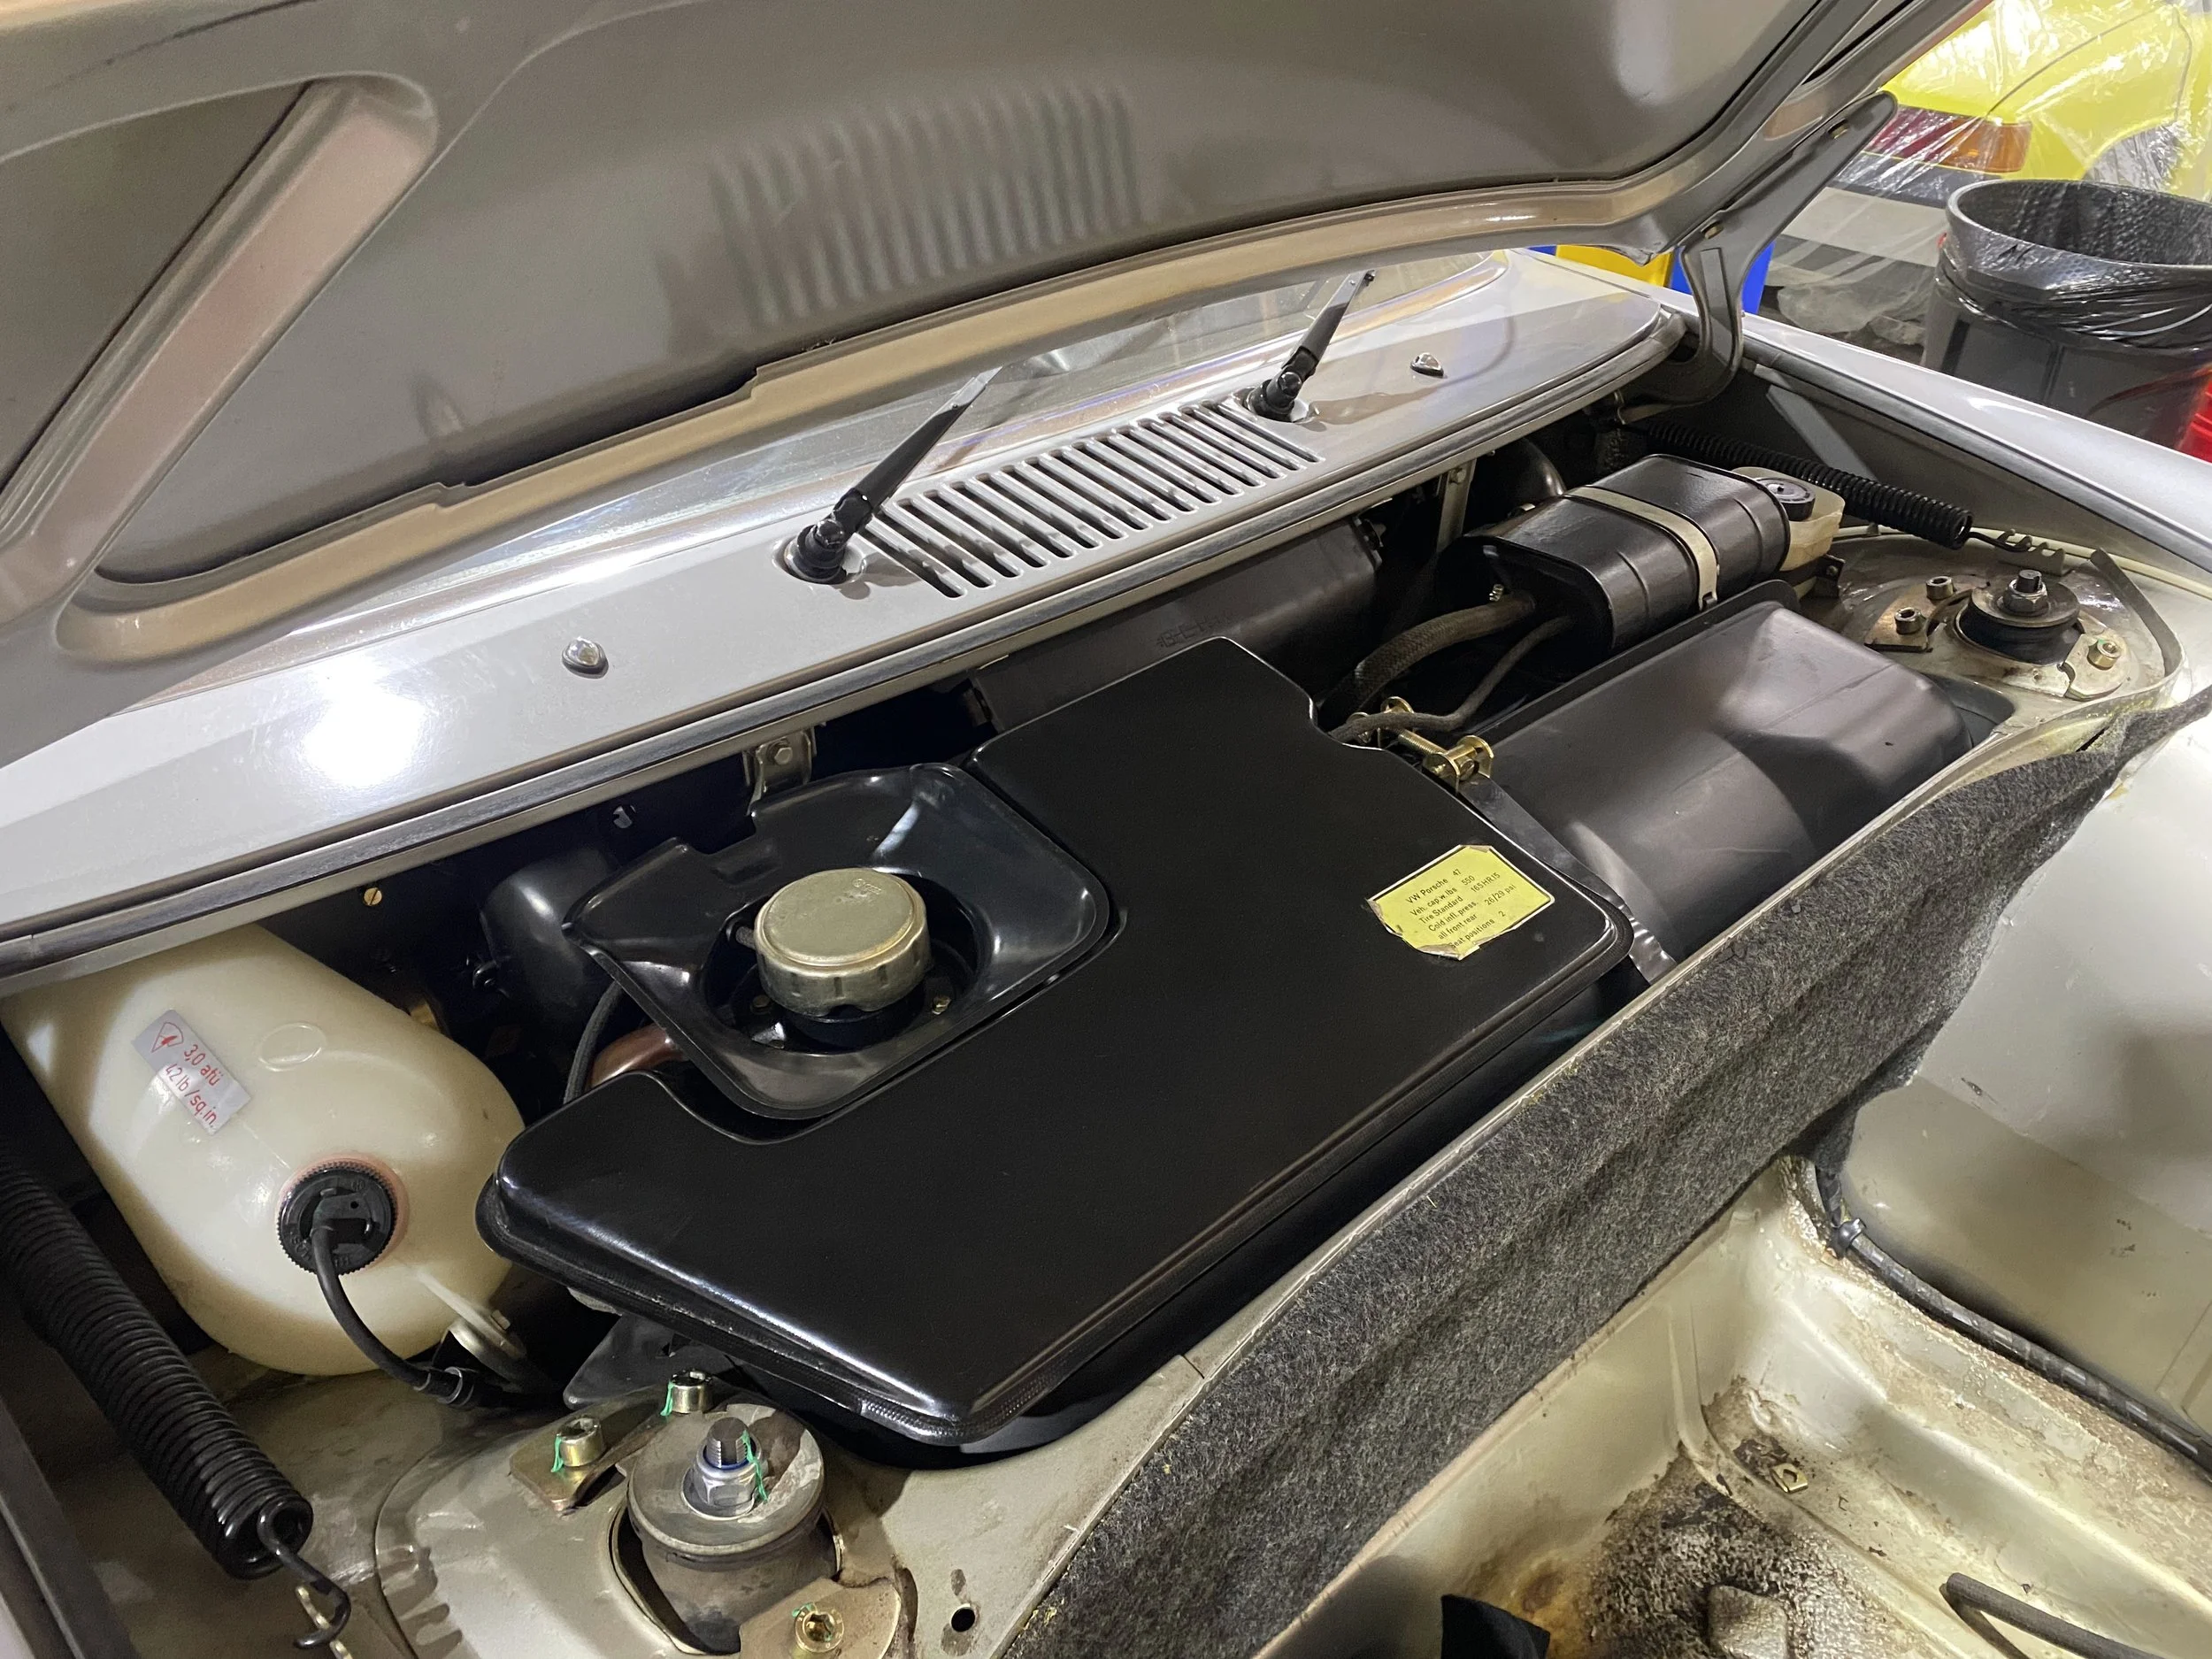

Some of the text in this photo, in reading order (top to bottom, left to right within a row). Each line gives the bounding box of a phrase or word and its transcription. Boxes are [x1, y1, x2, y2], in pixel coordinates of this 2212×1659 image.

[1406, 894, 1421, 903] VW
[1420, 878, 1448, 896] Porsche
[1462, 875, 1475, 886] 550
[1419, 914, 1434, 924] Tire
[1432, 895, 1463, 916] Standard
[1428, 919, 1446, 932] Cold
[1484, 890, 1505, 906] 26/29
[1447, 922, 1464, 934] front
[1463, 914, 1478, 925] rear
[1463, 918, 1495, 941] positions
[165, 1063, 182, 1082] 42
